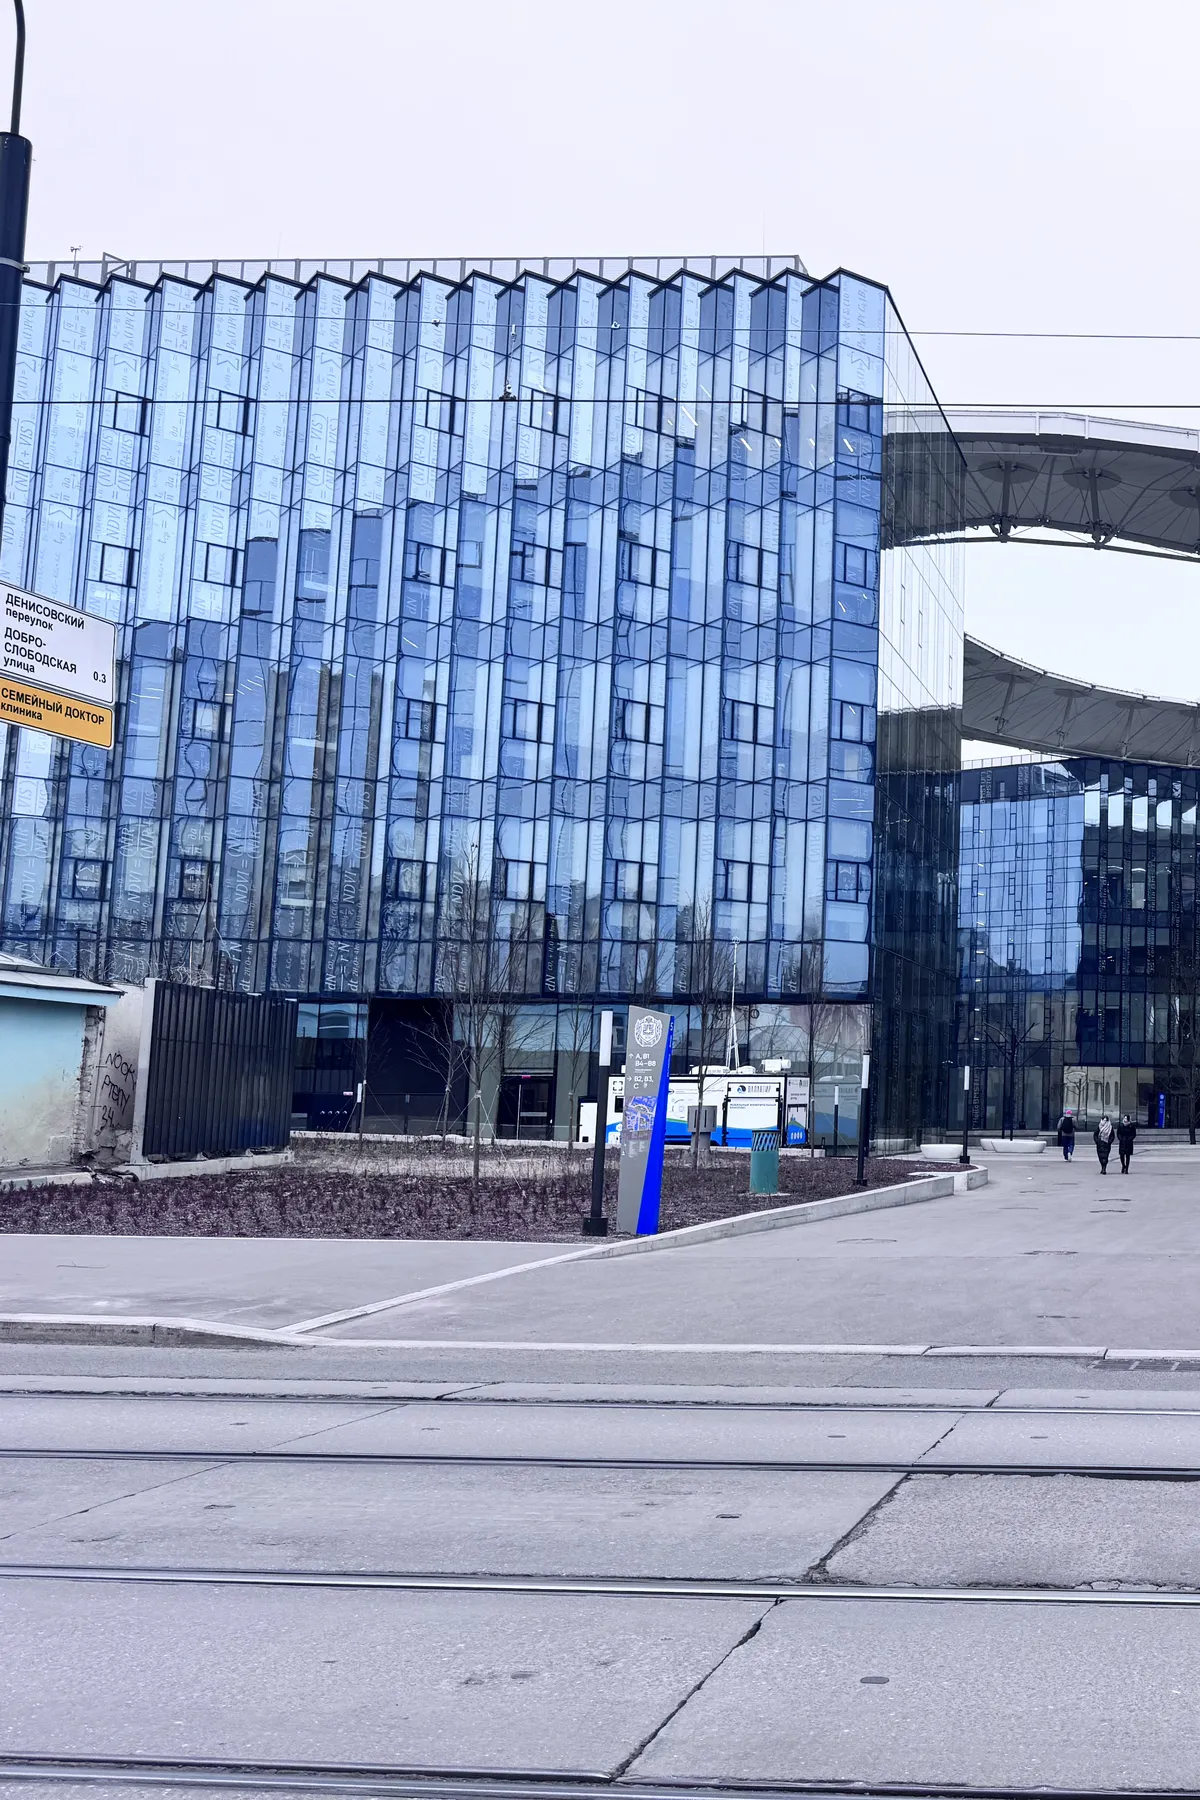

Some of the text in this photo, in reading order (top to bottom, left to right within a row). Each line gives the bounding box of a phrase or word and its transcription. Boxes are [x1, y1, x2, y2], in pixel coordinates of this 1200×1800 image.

[5, 593, 85, 629] ДЕНИСОВСКИЙ
[5, 607, 54, 631] переулок
[4, 627, 47, 648] ДОБРО-
[3, 656, 35, 673] улица
[4, 642, 77, 674] СЛОБОДСКАЯ
[93, 671, 107, 684] 0.3
[0, 703, 43, 721] клиника
[1, 687, 105, 725] СЕМЕЙНЫЙ ДОКТОР
